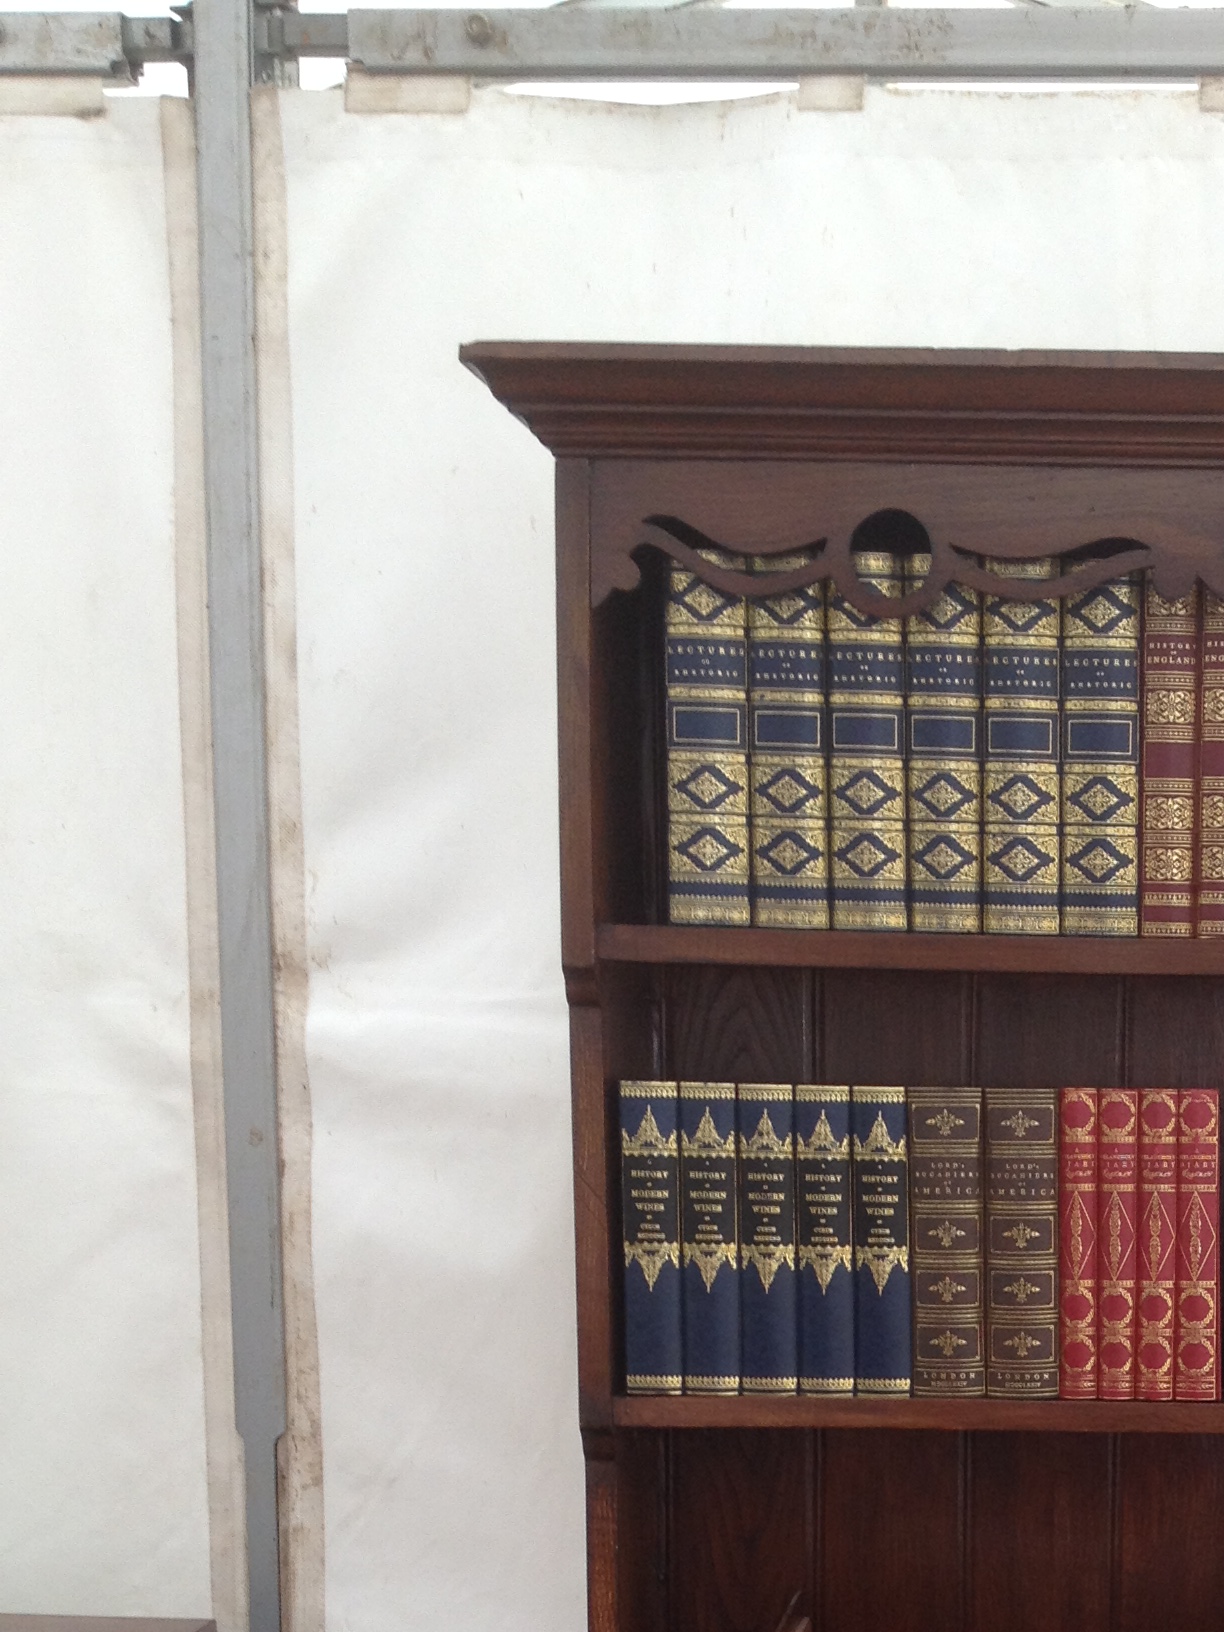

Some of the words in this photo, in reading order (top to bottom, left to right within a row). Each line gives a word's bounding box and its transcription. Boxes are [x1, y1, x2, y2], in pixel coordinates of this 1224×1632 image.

[1147, 656, 1196, 664] ENGLAND
[630, 1170, 668, 1179] HISTORY
[689, 1171, 727, 1180] HISTORY
[747, 1172, 784, 1181] HISTORY
[805, 1173, 842, 1183] HISTORY
[862, 1174, 898, 1183] HISTORY
[631, 1189, 669, 1198] MODERN
[689, 1190, 727, 1199] MODERN
[748, 1192, 785, 1201] MODERN
[805, 1193, 842, 1202] MODERN
[862, 1194, 899, 1203] MODERN
[635, 1202, 665, 1212] WINES
[693, 1203, 722, 1213] WINES
[752, 1205, 780, 1214] WINES
[809, 1206, 837, 1215] WINES
[865, 1207, 894, 1216] WINES
